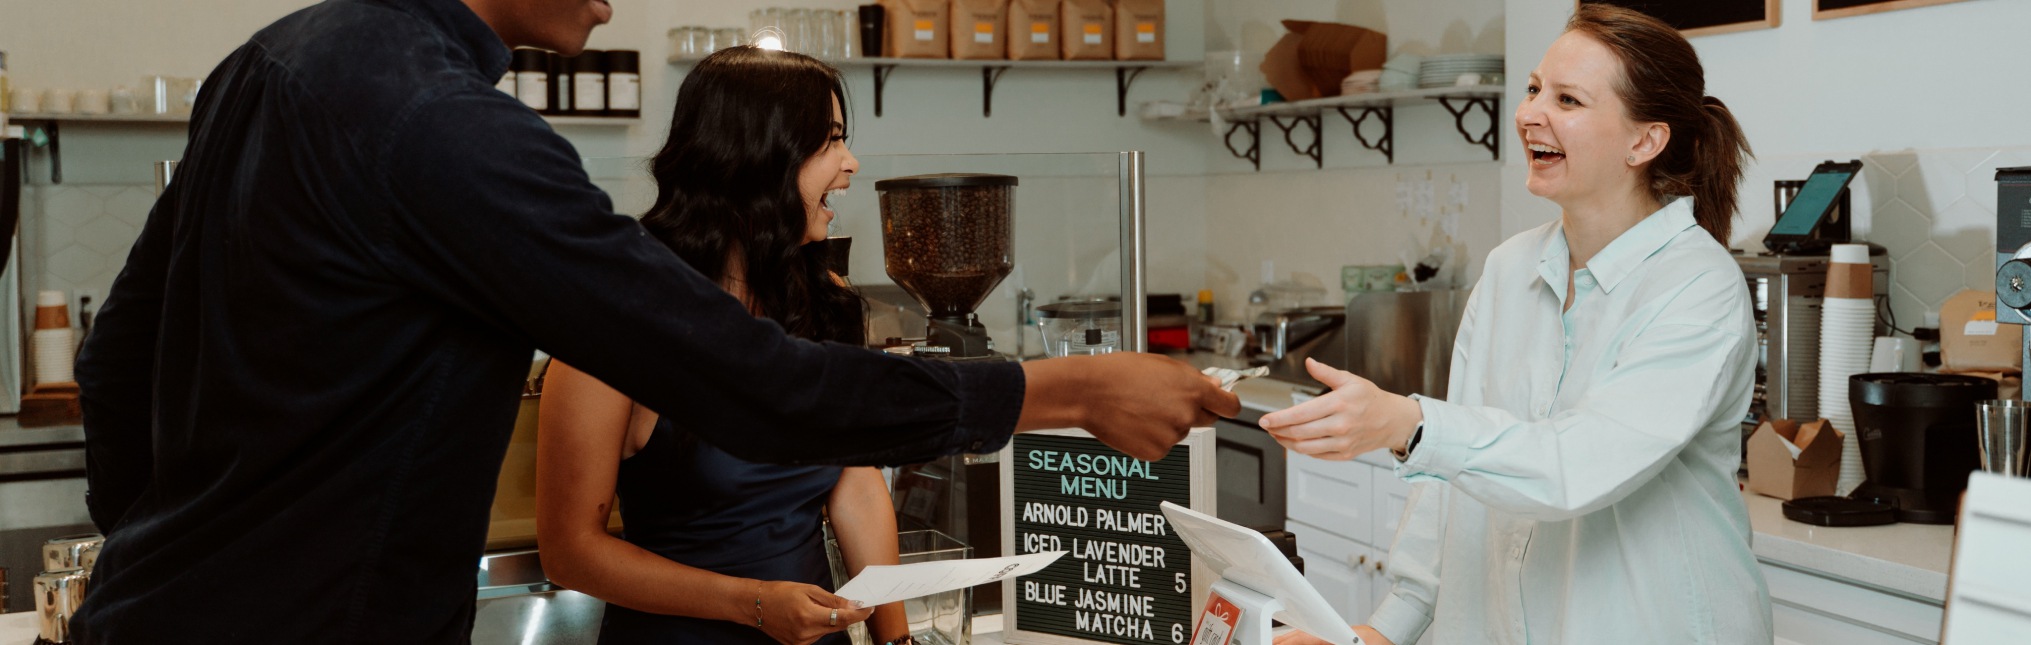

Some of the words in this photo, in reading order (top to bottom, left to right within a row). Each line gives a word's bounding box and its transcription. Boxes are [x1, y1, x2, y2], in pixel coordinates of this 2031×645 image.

[1028, 449, 1159, 480] SEASONAL
[1060, 475, 1127, 500] MENU
[1022, 502, 1088, 528] ARNOLD
[1096, 508, 1166, 536] PALMER
[1023, 532, 1061, 554] ICED
[1073, 538, 1165, 568] LAVENDER
[1083, 562, 1141, 588] LATTE
[1174, 573, 1187, 593] 5
[1024, 580, 1067, 606] BLUE
[1074, 588, 1155, 618] JASMINE
[1075, 610, 1154, 641] MATCHA
[1171, 623, 1184, 644] 6
